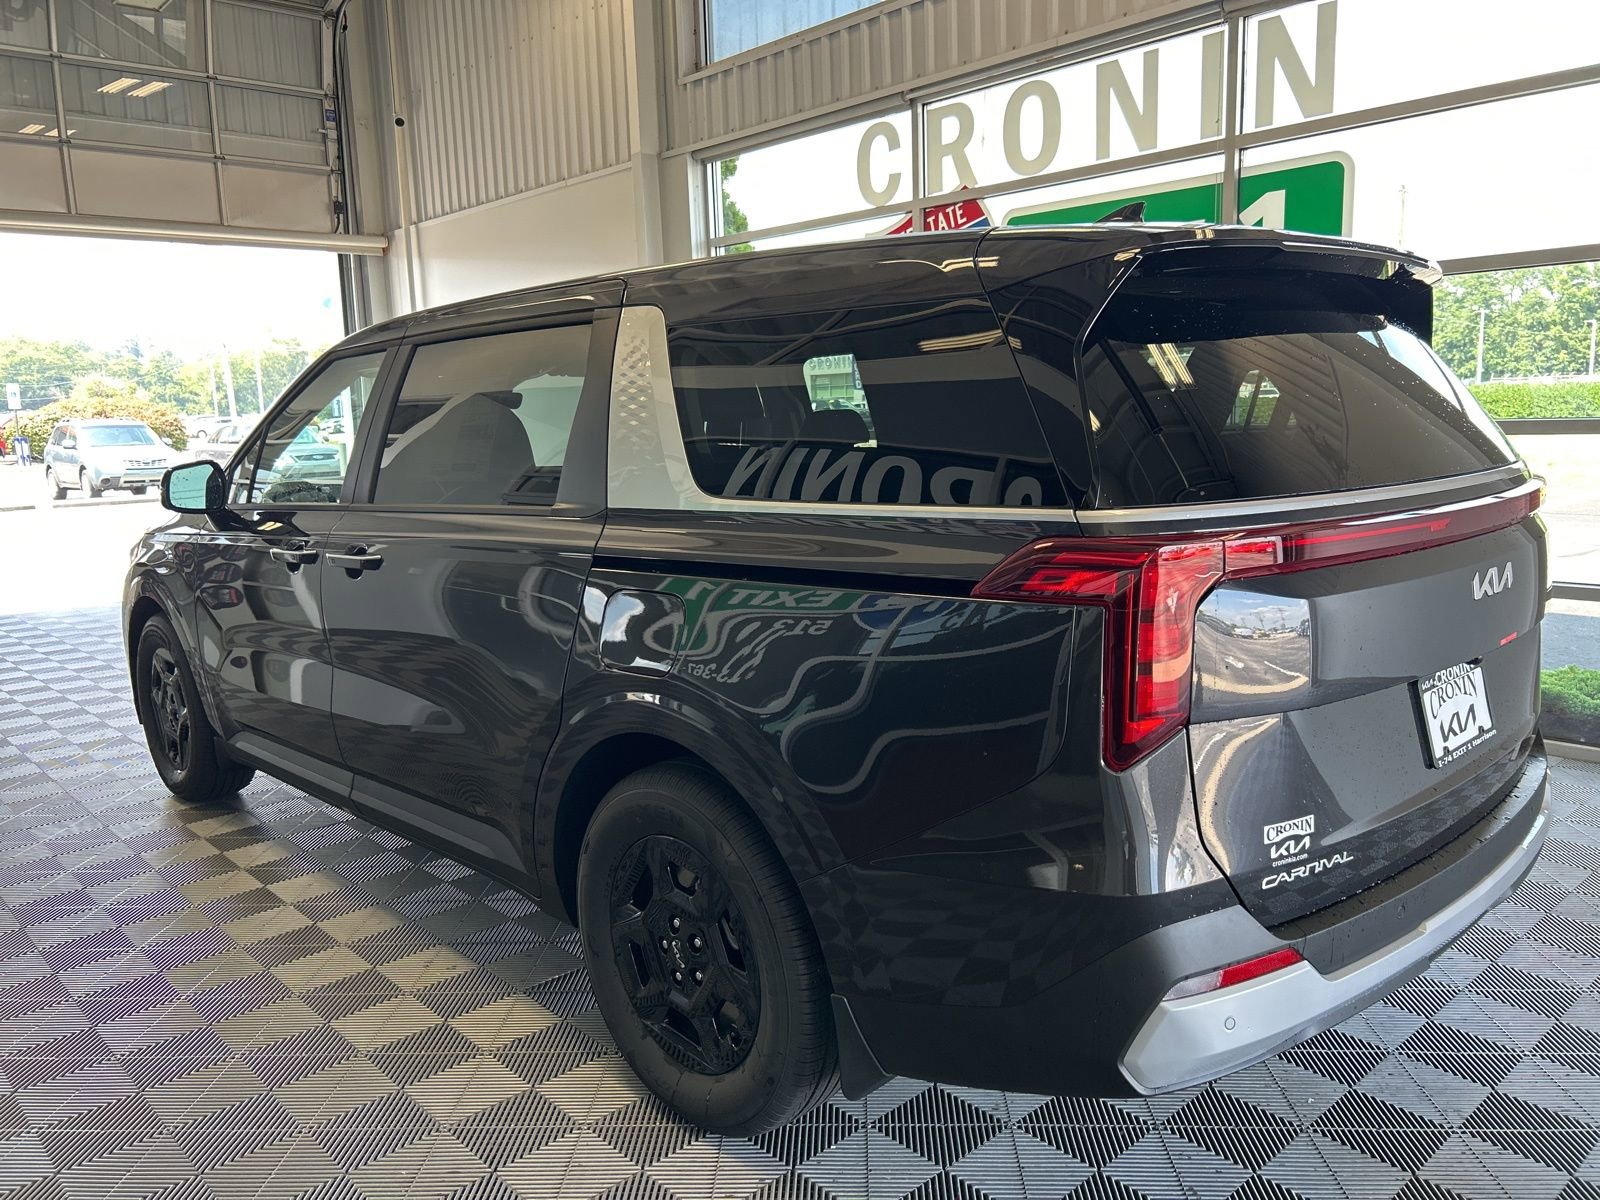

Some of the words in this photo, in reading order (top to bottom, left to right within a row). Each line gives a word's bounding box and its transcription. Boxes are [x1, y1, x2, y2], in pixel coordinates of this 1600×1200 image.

[856, 0, 1339, 208] CRONIN
[1472, 561, 1514, 601] KIA
[1434, 662, 1473, 687] CRONIN
[1429, 671, 1479, 720] CRONIN
[1439, 703, 1477, 744] KIA
[1452, 745, 1467, 759] EXIT
[1471, 729, 1497, 747] Harrison
[1266, 817, 1313, 842] CRONIN
[1270, 835, 1311, 859] KIA
[1262, 851, 1354, 890] CARNIVAL
